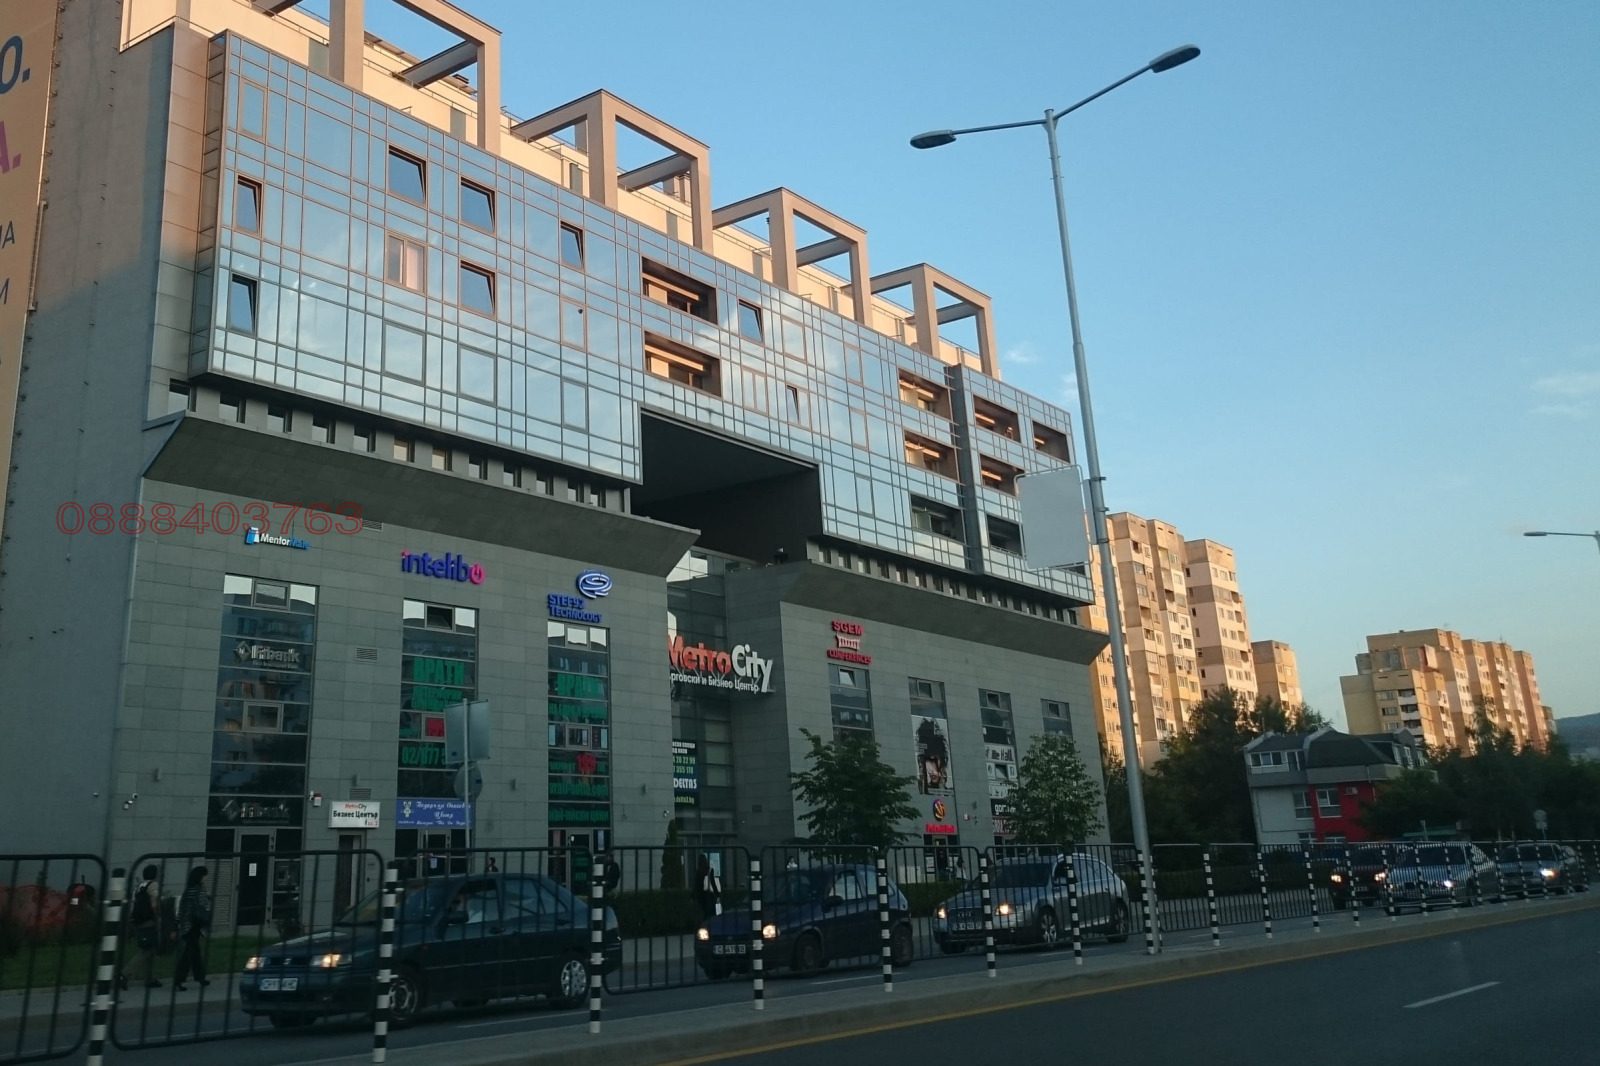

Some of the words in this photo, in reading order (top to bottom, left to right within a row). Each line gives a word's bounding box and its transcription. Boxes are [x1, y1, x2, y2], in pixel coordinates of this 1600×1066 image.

[832, 620, 863, 636] SGEM
[827, 649, 872, 665] CONFERENCES
[333, 810, 355, 819] Бизнес
[356, 810, 378, 820] Център
